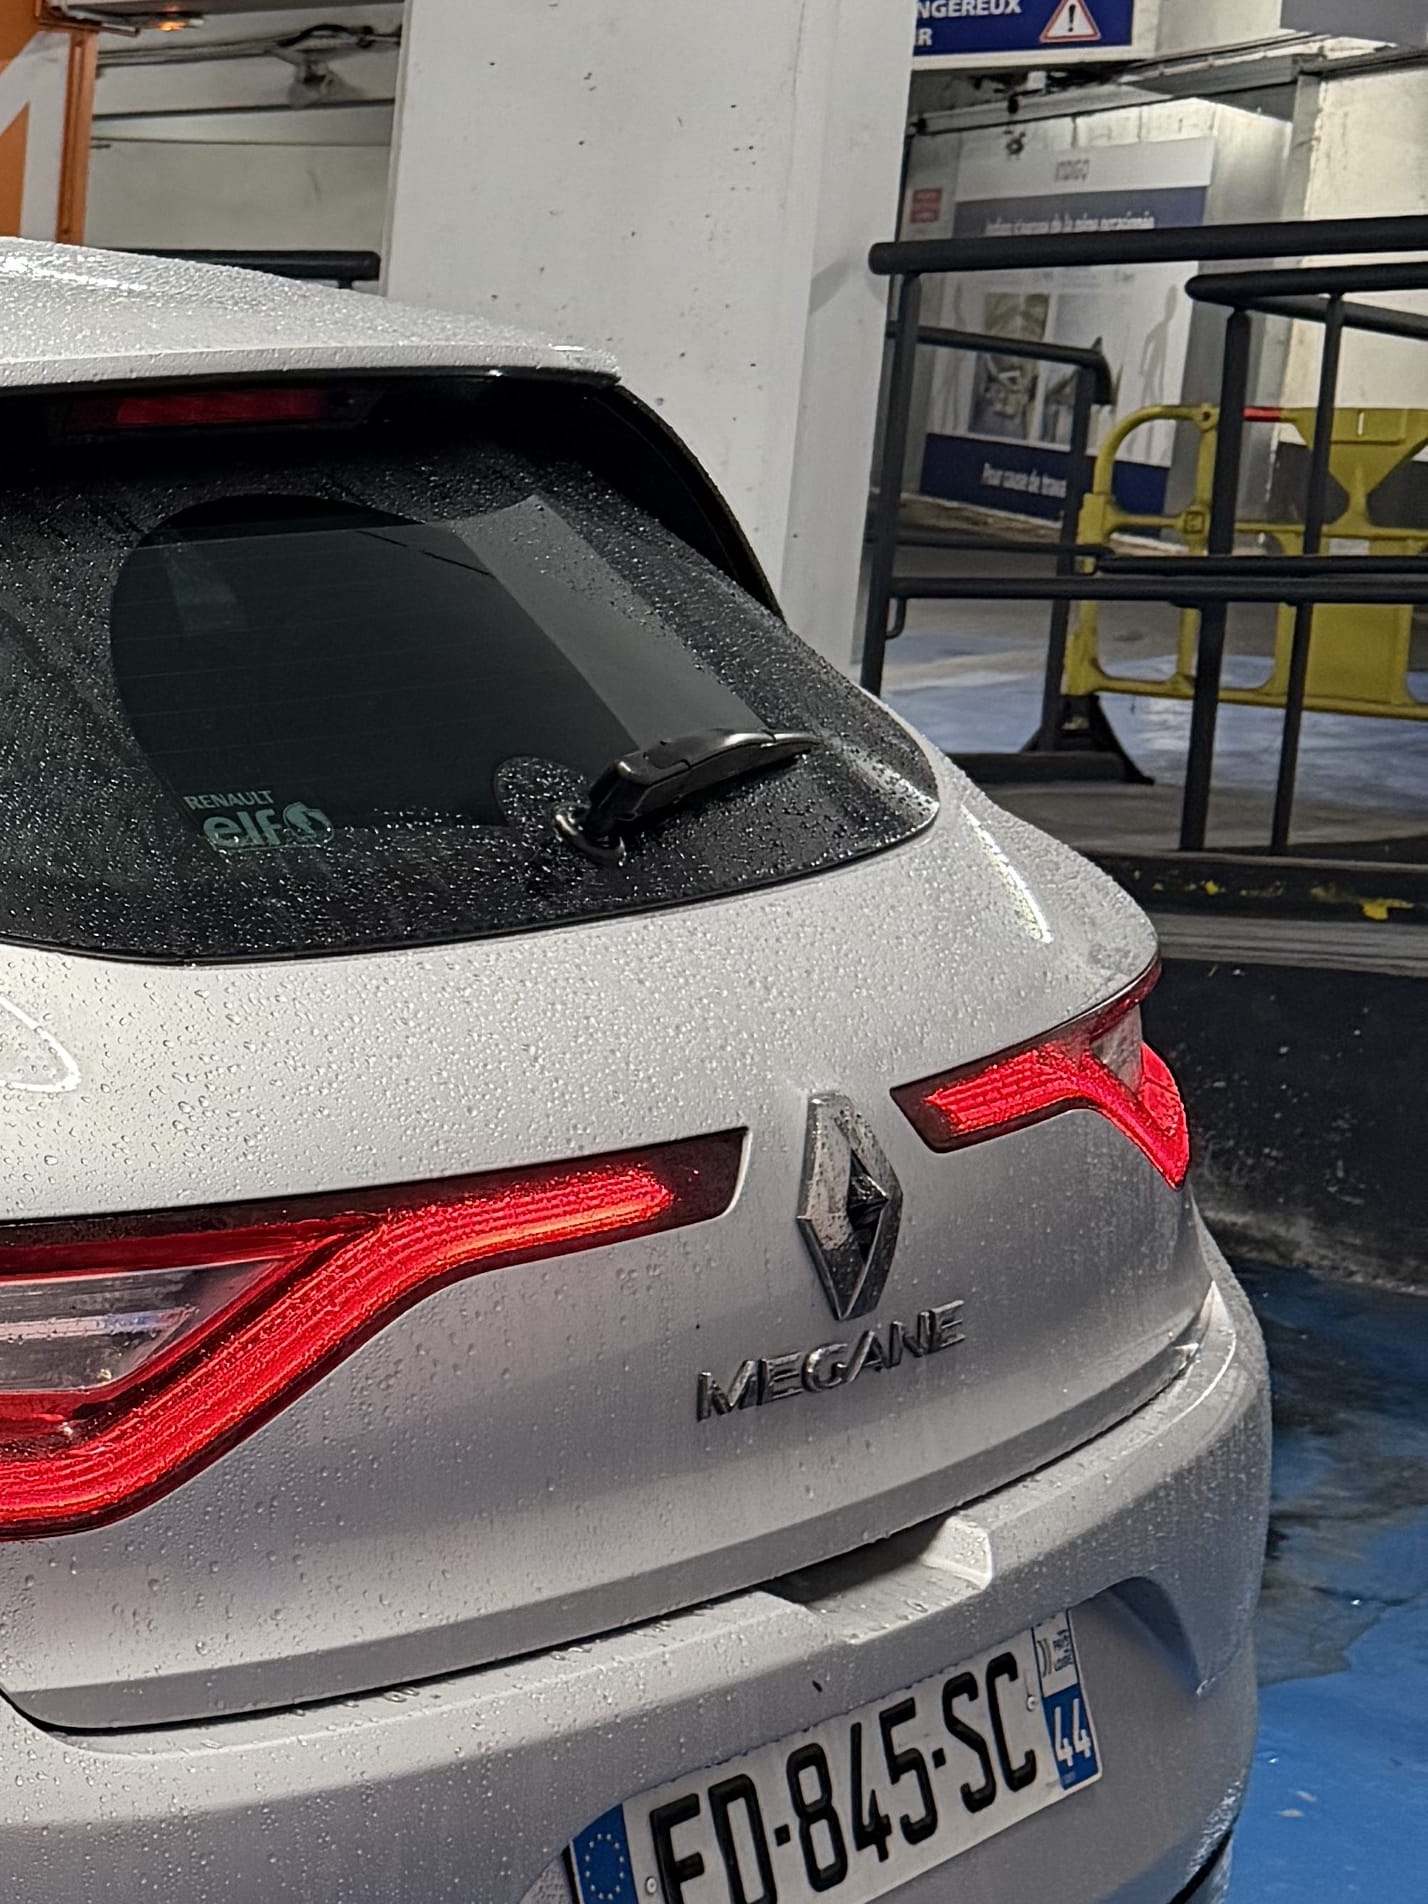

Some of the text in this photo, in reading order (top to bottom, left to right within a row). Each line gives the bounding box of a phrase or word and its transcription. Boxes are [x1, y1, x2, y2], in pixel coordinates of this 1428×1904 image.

[914, 28, 933, 46] R
[183, 790, 276, 810] RENAULT
[203, 809, 284, 847] elf
[696, 1300, 966, 1423] MEGANE
[1053, 1698, 1093, 1768] 44
